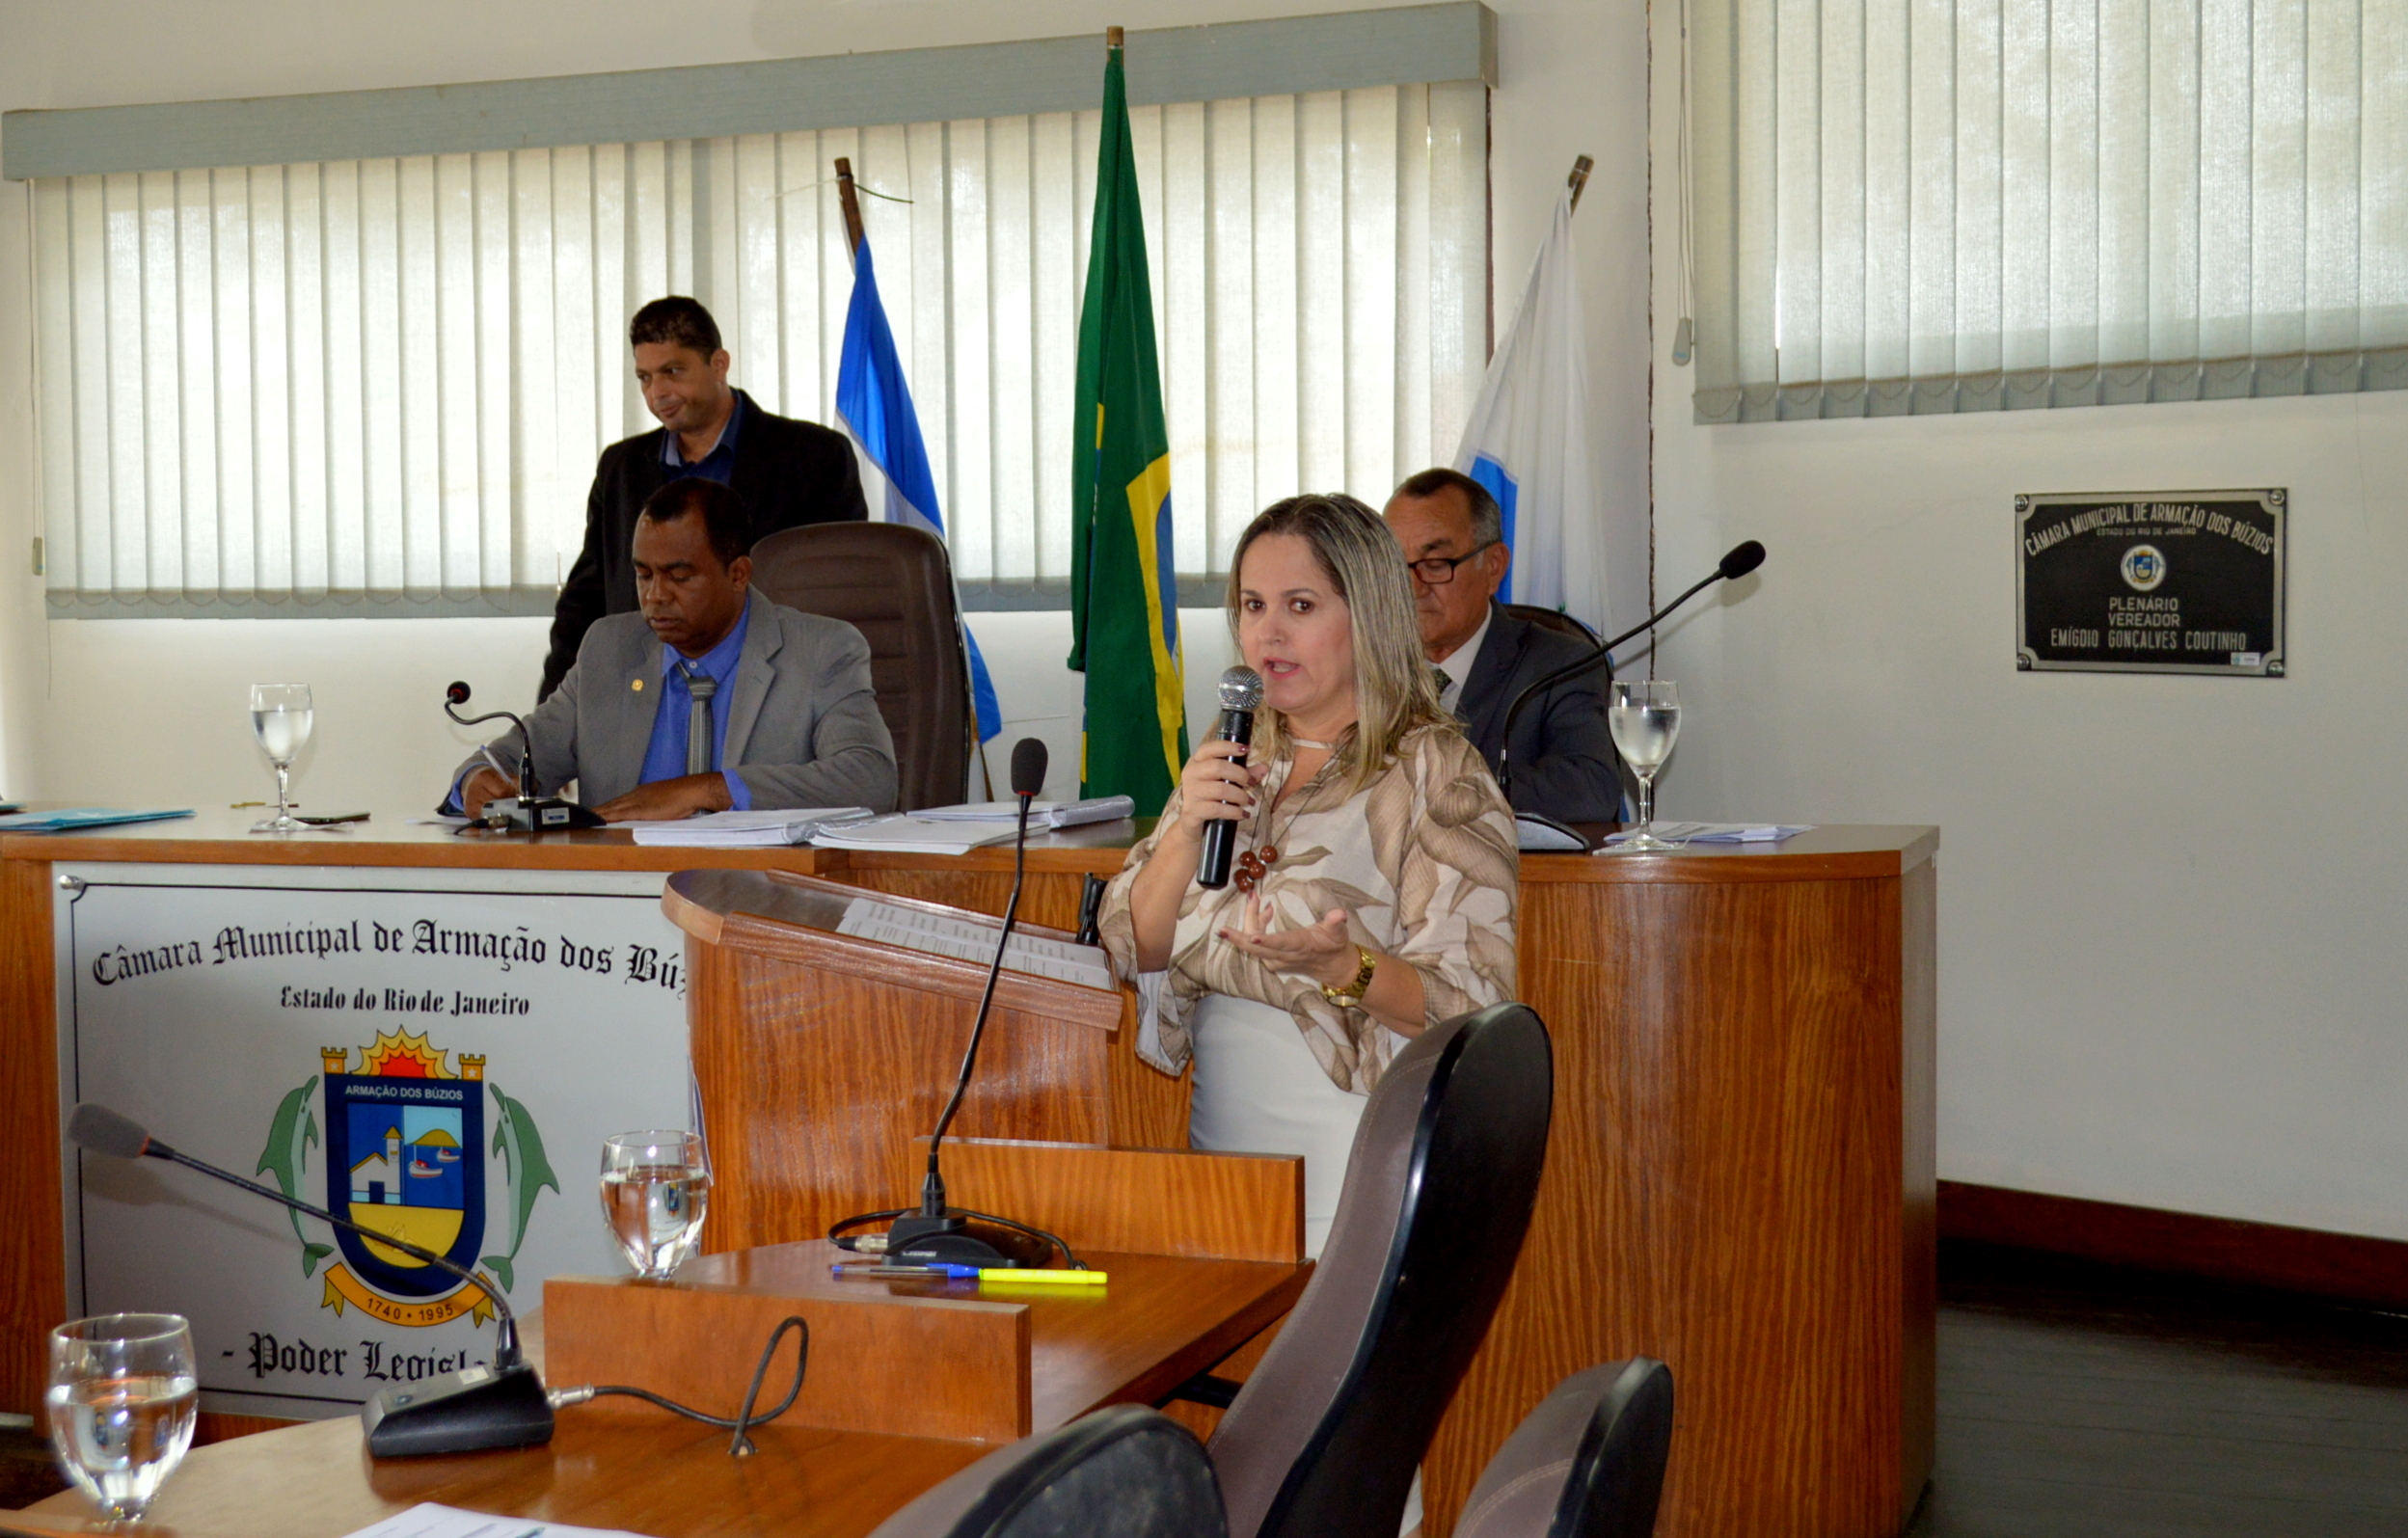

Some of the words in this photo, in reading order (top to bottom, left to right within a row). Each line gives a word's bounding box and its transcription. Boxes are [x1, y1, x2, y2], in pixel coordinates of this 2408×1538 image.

[2025, 522, 2070, 556] CÂMARA
[2070, 504, 2130, 535] MUNICIPAL
[2133, 502, 2148, 522] DE
[2150, 502, 2205, 528] ARMAÇÃO
[2206, 512, 2232, 535] DOS
[2231, 521, 2274, 555] BÚZIOS
[2096, 527, 2124, 536] ESTADO
[2125, 527, 2136, 536] DO
[2137, 527, 2151, 536] RIO
[2152, 527, 2162, 536] DE
[2165, 526, 2197, 535] JANEIRO
[2109, 595, 2178, 611] PLENÁRIO
[2108, 612, 2180, 627] VEREADOR
[2050, 626, 2098, 648] EMÍGDIO
[2108, 630, 2178, 652] GONÇALVES
[2184, 632, 2246, 651] COUTINHO
[93, 940, 203, 985] Câmara
[212, 919, 362, 965] Municipal
[372, 920, 404, 953] de
[412, 919, 546, 972] Armação
[560, 934, 614, 974] dos
[624, 944, 686, 1001] Bú
[281, 985, 345, 1009] Estado
[353, 987, 376, 1011] do
[384, 987, 417, 1012] Rio
[420, 989, 445, 1012] de
[450, 990, 529, 1016] Janeiro
[345, 1085, 398, 1098] ARMAÇÃO
[400, 1088, 421, 1098] DOS
[424, 1087, 463, 1100] BÚZIOS
[366, 1298, 400, 1320] 1740
[419, 1304, 453, 1321] 1995
[248, 1332, 347, 1378] Poder
[360, 1339, 487, 1382] Legisl
